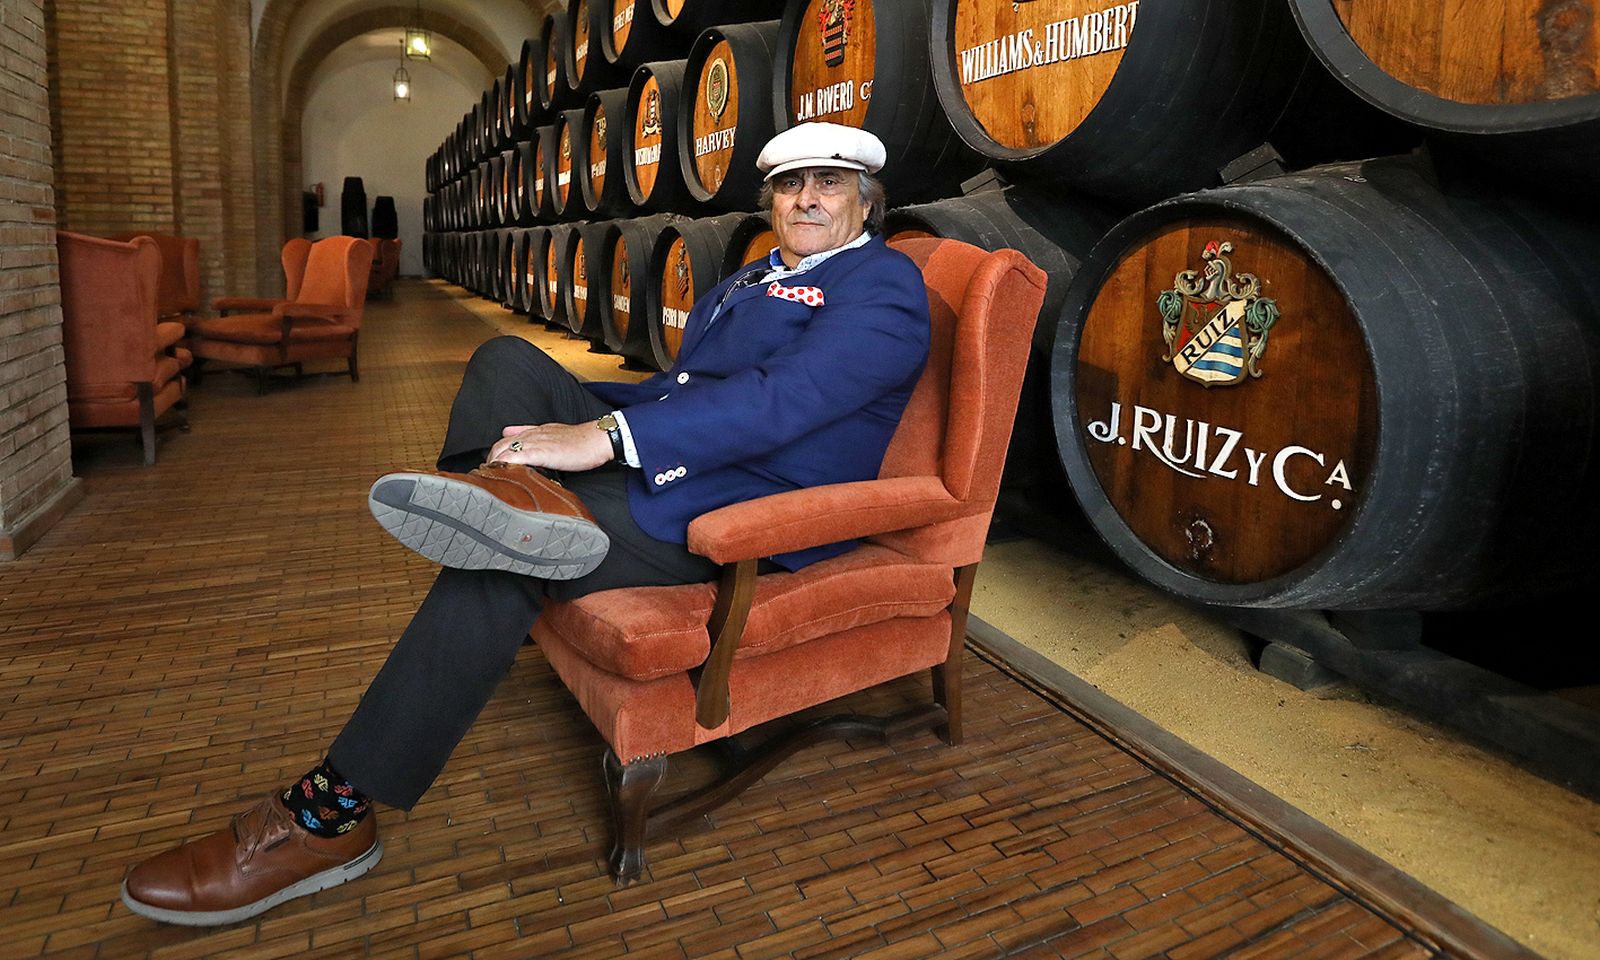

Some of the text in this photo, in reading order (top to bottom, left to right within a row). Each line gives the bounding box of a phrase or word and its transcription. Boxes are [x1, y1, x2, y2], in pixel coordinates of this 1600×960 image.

[816, 79, 854, 117] RIVERO
[695, 126, 737, 157] HARVEY
[1179, 309, 1235, 365] RUIZ
[1131, 404, 1243, 480] RUIZ
[1244, 447, 1267, 487] Y
